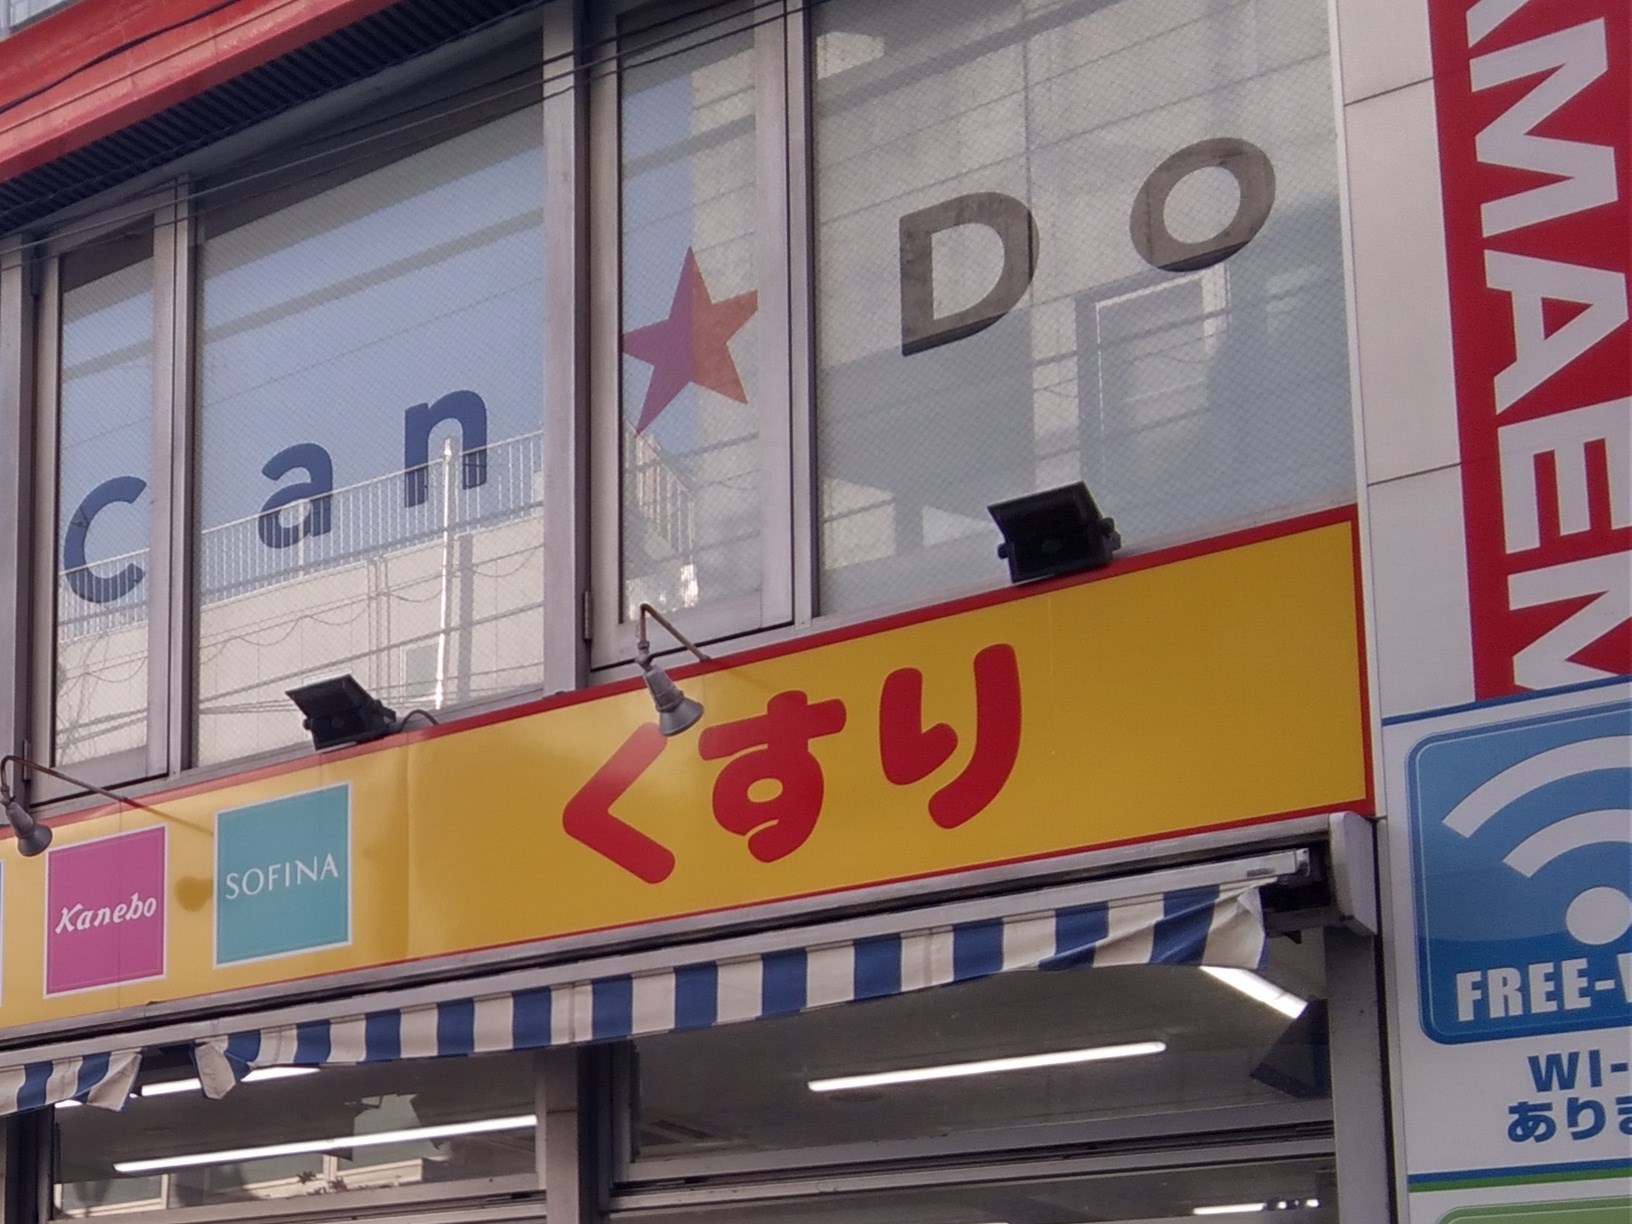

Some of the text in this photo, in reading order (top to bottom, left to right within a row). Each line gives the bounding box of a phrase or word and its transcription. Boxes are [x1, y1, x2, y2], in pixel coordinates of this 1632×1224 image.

[562, 643, 1022, 885] くすり
[225, 852, 340, 901] SOFINA
[54, 892, 158, 936] Kanebo
